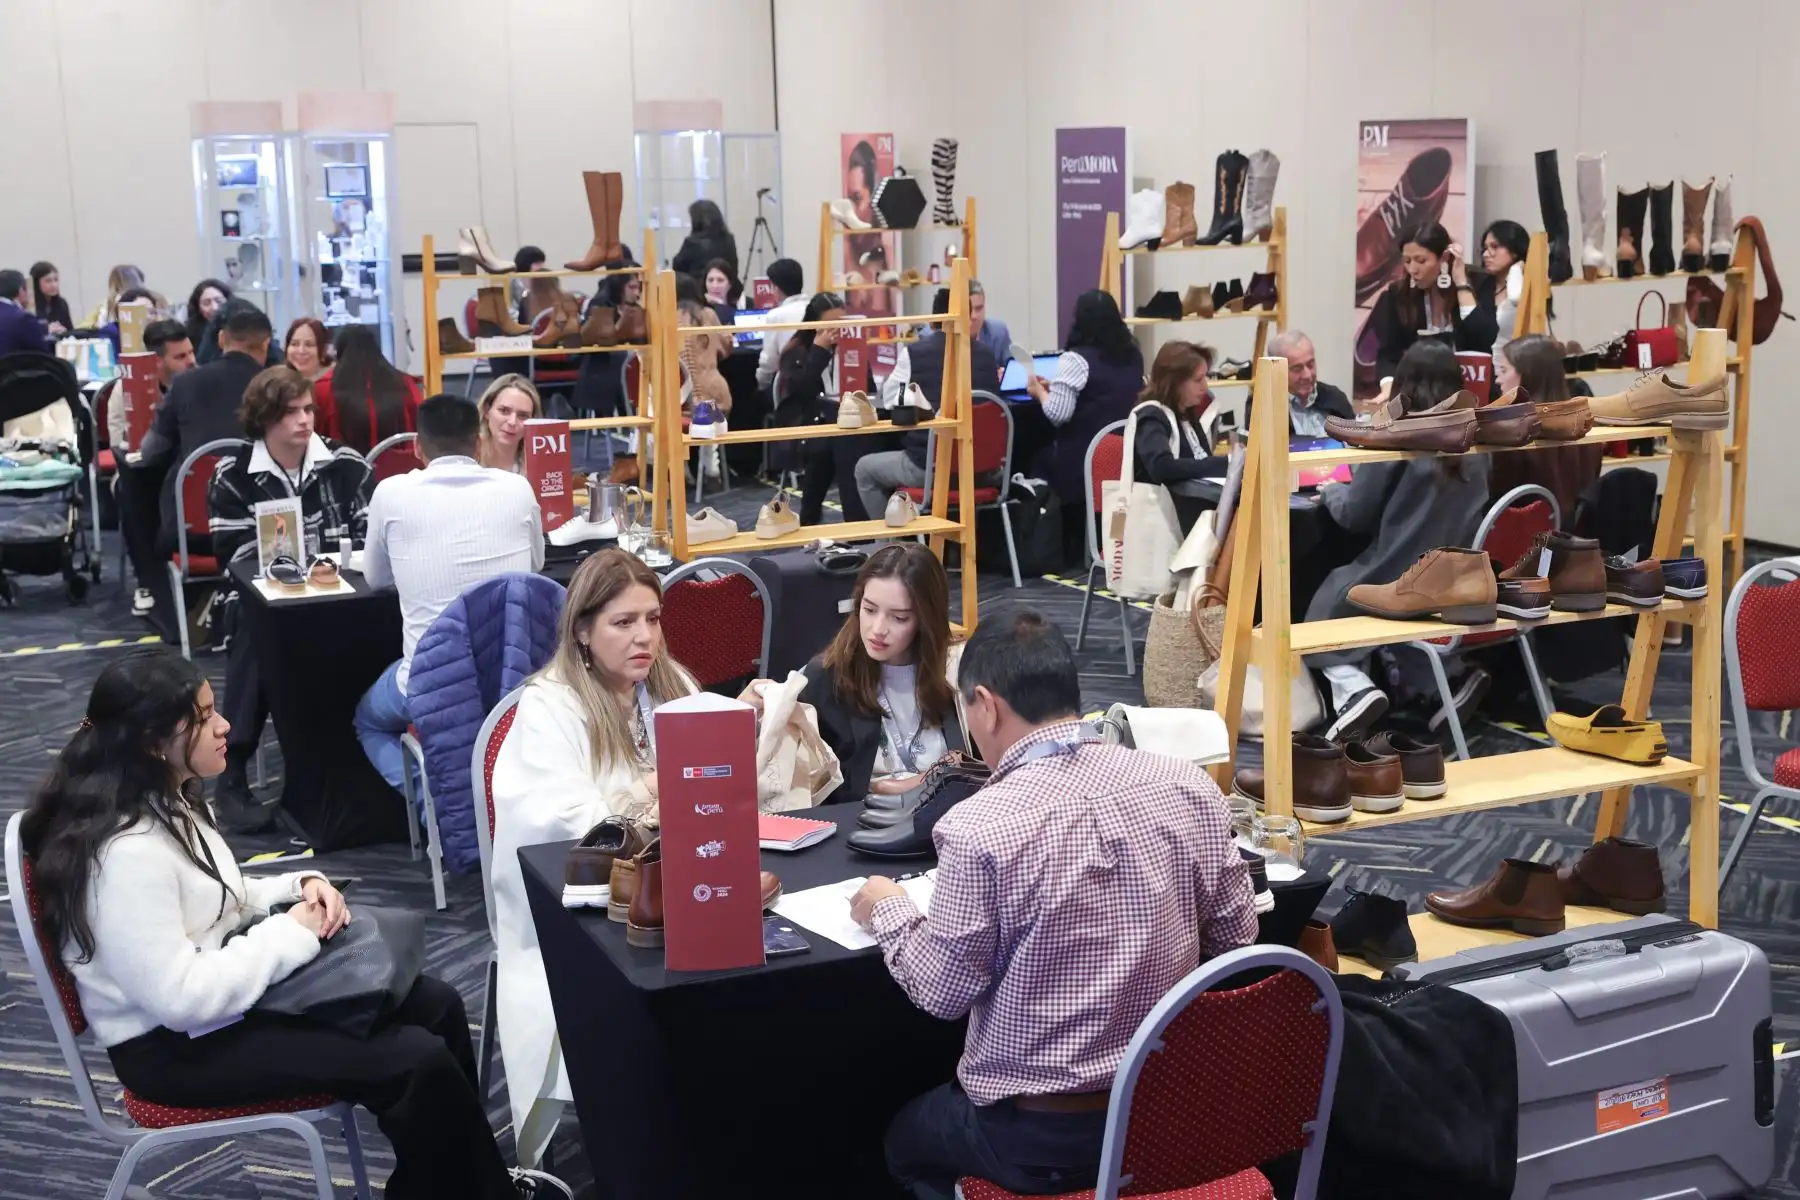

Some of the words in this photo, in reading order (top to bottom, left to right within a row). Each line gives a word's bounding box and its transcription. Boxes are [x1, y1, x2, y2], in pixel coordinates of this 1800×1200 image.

[1363, 125, 1389, 147] PM
[532, 434, 567, 455] PM
[545, 471, 562, 479] BACK
